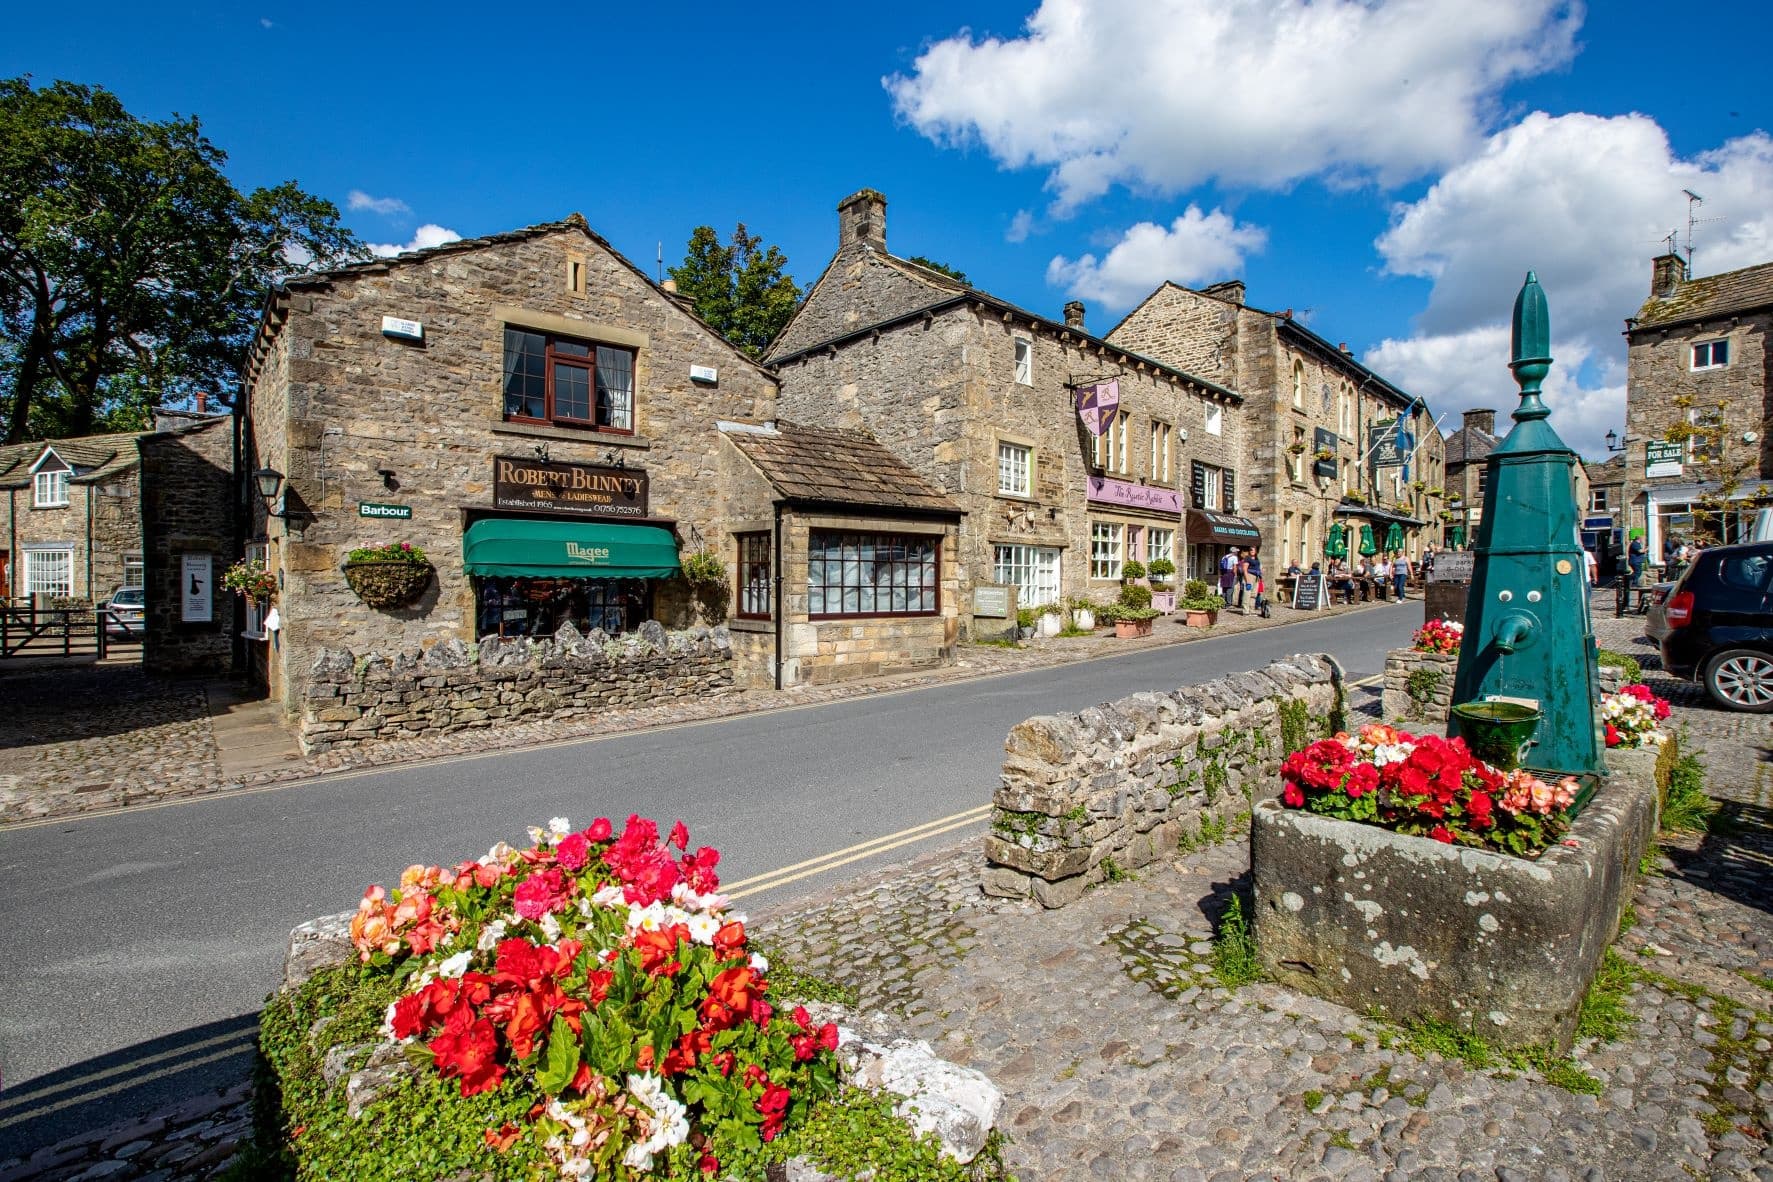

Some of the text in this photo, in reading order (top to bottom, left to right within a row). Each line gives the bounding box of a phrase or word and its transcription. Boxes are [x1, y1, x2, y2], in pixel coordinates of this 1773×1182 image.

[1648, 449, 1682, 459] FOR SALE
[499, 461, 644, 494] ROBERT BUNNEY
[498, 497, 536, 508] Established
[567, 492, 611, 503] LADIESWEAR
[566, 542, 609, 561] Magee
